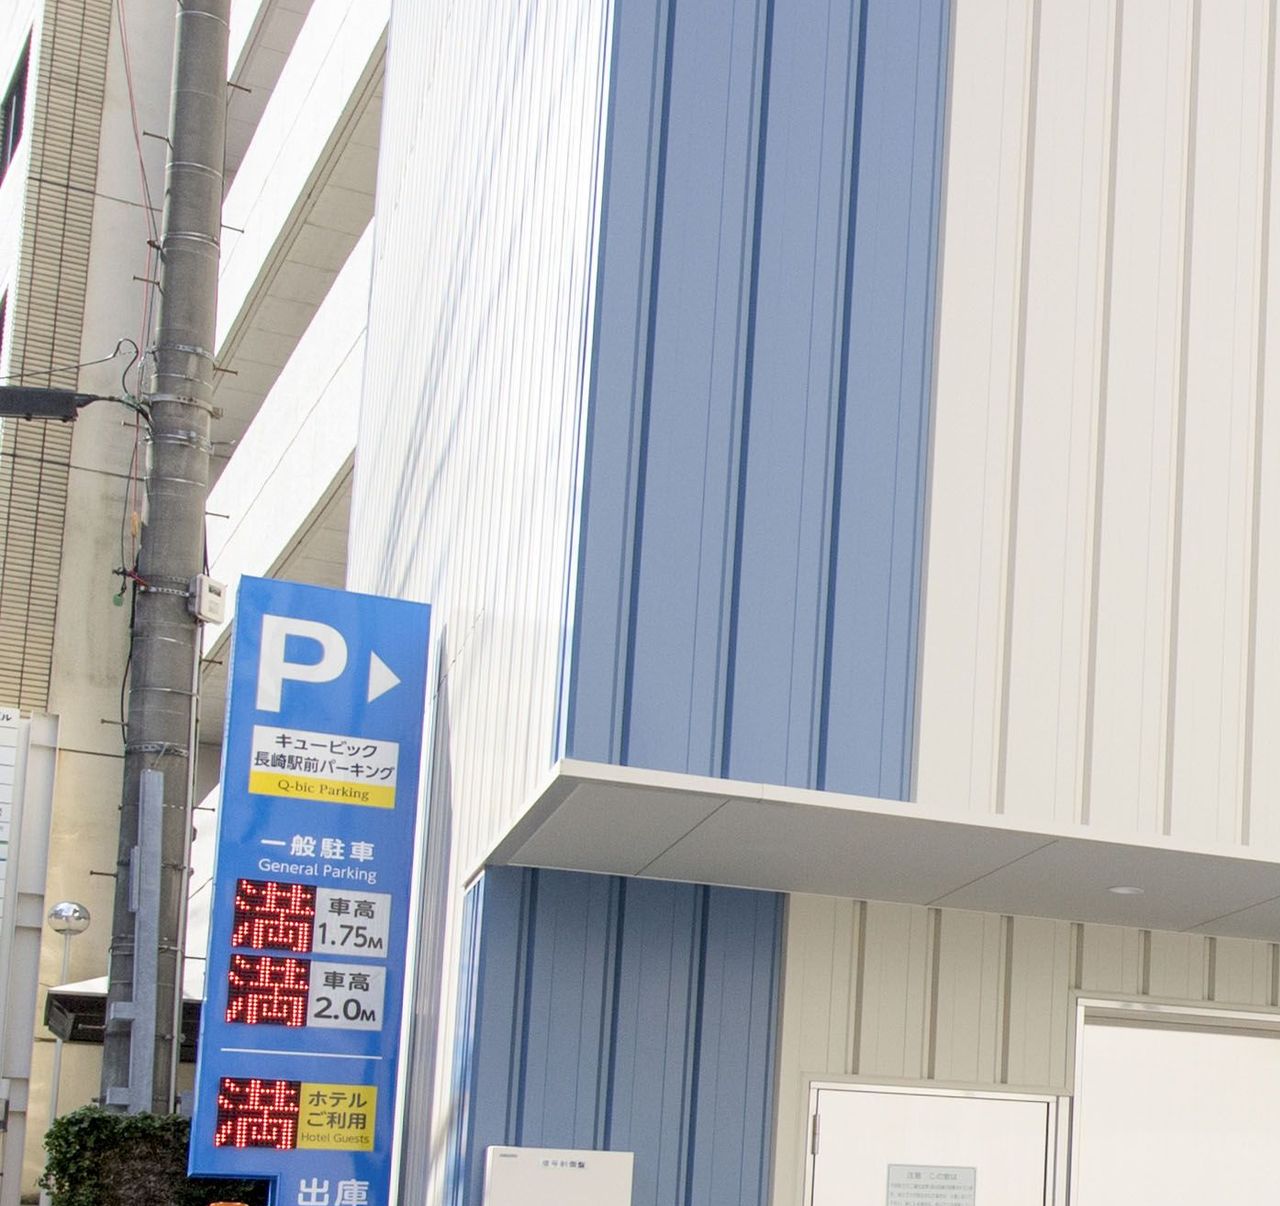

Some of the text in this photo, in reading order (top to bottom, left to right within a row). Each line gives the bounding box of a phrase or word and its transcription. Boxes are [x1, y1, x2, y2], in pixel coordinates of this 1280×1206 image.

[255, 613, 348, 713] P
[275, 733, 378, 759] キュービック
[254, 750, 396, 781] 長崎駅前パーキング
[277, 778, 370, 802] Q-bic Parking
[260, 833, 376, 863] 一般駐車
[258, 857, 378, 885] General Parking
[231, 879, 315, 952] 満
[327, 897, 377, 920] 車高
[318, 922, 384, 950] 1.75M
[225, 955, 309, 1027] 満
[322, 970, 371, 992] 車高
[313, 996, 377, 1022] 2.0M
[308, 1090, 367, 1109] ホテル
[214, 1078, 300, 1149] 満
[306, 1111, 367, 1130] ご利用
[301, 1131, 370, 1144] Hotel Guests
